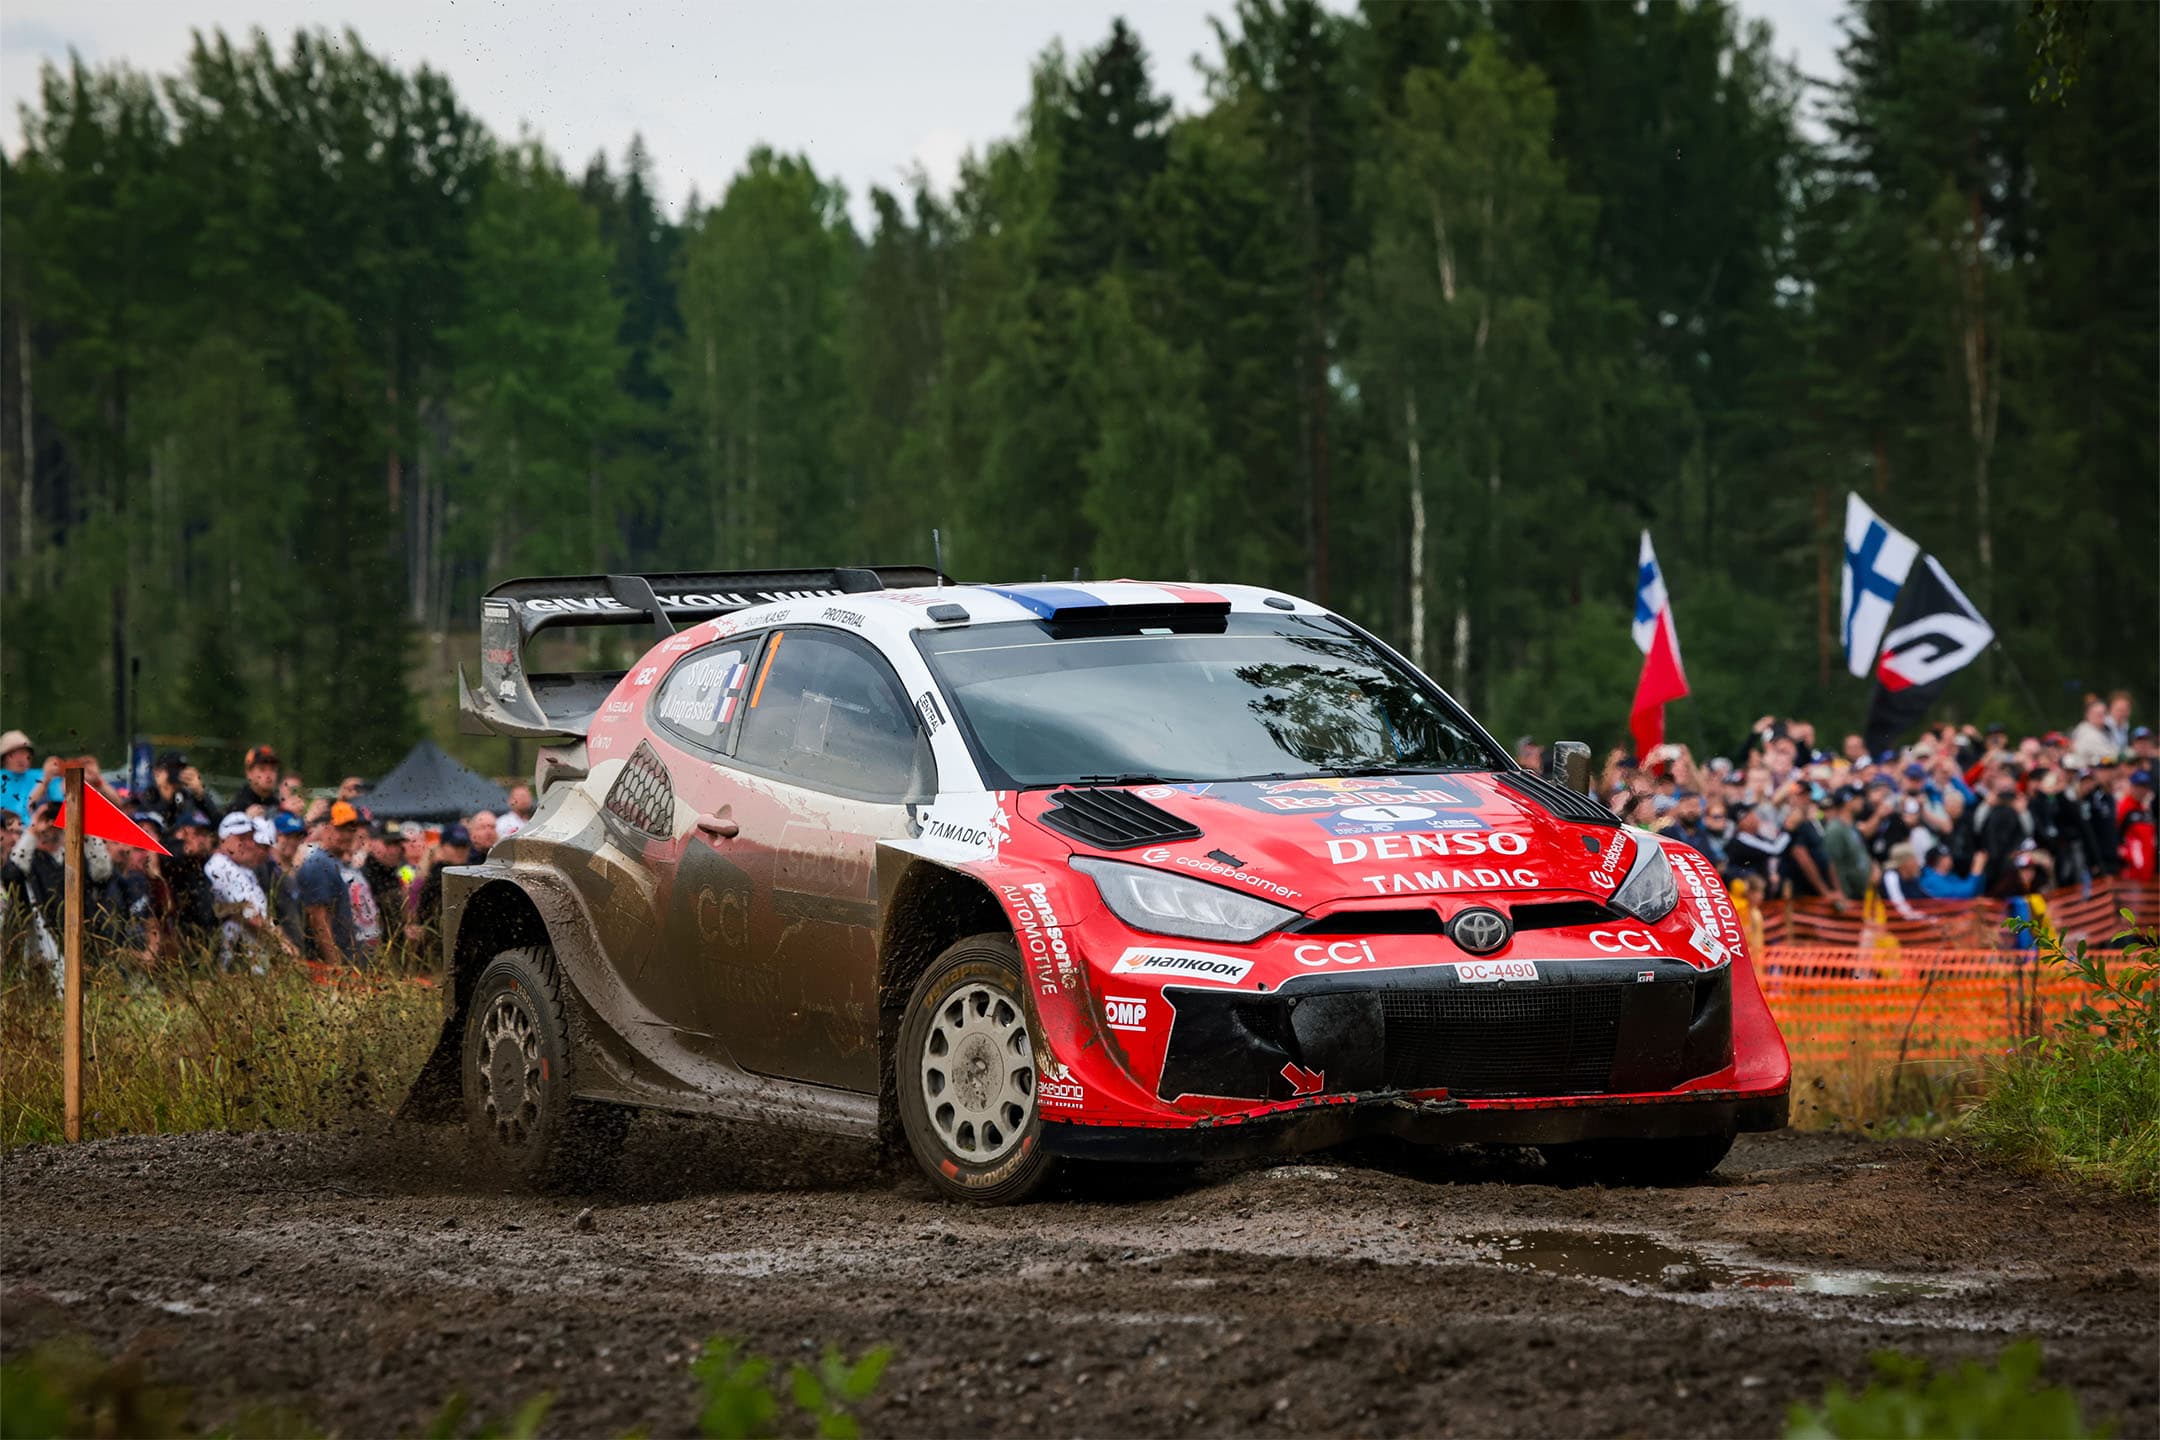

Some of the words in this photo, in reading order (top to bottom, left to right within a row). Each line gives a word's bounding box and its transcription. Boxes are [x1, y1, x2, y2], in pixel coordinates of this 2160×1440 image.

[654, 592, 752, 608] YOU
[820, 606, 867, 628] PROTERIAL
[750, 630, 785, 709] 1
[918, 694, 941, 733] CENTRAL
[1257, 791, 1372, 811] Red
[1353, 789, 1463, 805] Bull
[1375, 807, 1400, 819] 1
[929, 820, 987, 846] TAMADIC
[1325, 831, 1529, 865] DENSO
[1175, 853, 1299, 899] codebeamer
[1362, 868, 1541, 895] TAMADIC
[1668, 853, 1721, 938] anasonic
[1684, 851, 1745, 958] AUTOMOTIVE
[1000, 884, 1058, 996] AUTOMOTIVE
[1022, 881, 1078, 990] Panasonic
[1459, 960, 1535, 982] OC-4490
[1105, 1001, 1147, 1025] OMP
